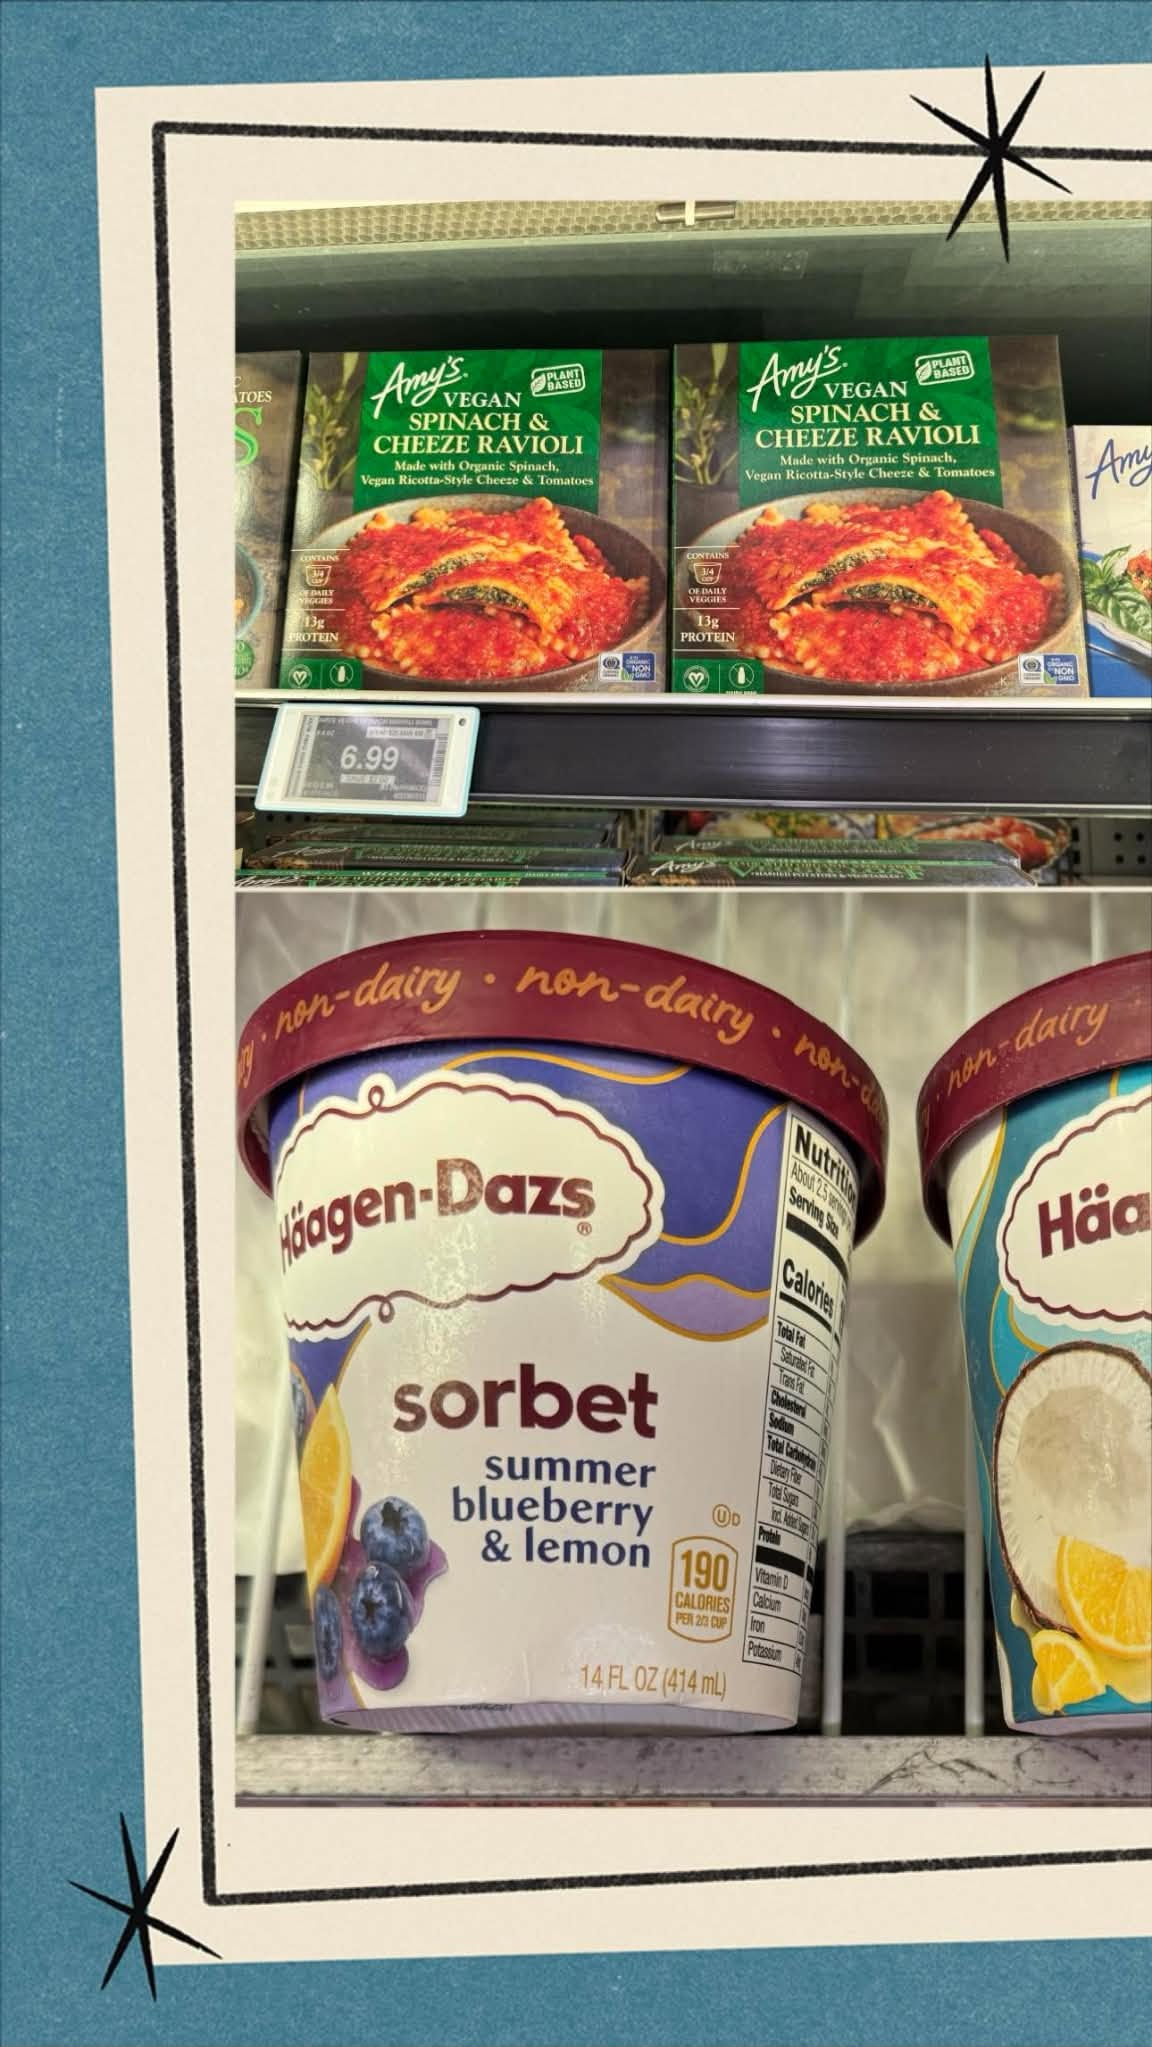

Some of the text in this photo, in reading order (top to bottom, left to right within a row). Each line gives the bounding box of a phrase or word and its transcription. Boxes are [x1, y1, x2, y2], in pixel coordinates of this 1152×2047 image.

[932, 355, 966, 369] PLANT
[547, 368, 580, 380] PLANT
[746, 344, 842, 413] Amy's
[933, 366, 970, 380] BASED
[370, 355, 464, 420] Amy's
[547, 379, 582, 391] BASED
[824, 381, 909, 399] VEGAN
[443, 392, 522, 408] VEGAN
[409, 412, 549, 431] SPINACH &
[791, 401, 942, 424] SPINACH &
[373, 435, 584, 455] CHEEZE RAVIOLI
[755, 425, 982, 449] CHEEZE RAVIOLI
[394, 460, 560, 475] Made with Organic Spinach,
[780, 452, 957, 467] Made with Organic Spinach,
[361, 474, 594, 487] Vegan Ricotta-Style Cheeze & Tomatoes
[744, 467, 995, 482] Vegan Ricotta-Style Cheeze & Tomatoes
[687, 552, 729, 560] CONTAINS
[689, 595, 727, 603] VEGGIES
[701, 587, 727, 595] DAILY
[304, 616, 325, 630] 13g
[697, 615, 719, 629] 13g
[289, 632, 339, 643] PROTEIN
[680, 632, 736, 643] PROTEIN
[340, 744, 399, 770] 6.99
[274, 961, 461, 1040] non-dairy
[515, 965, 755, 1046] non-dairy
[947, 1003, 1110, 1096] non-dairy
[791, 1160, 816, 1194] About
[279, 1157, 597, 1276] Häagen-Dazs
[788, 1185, 825, 1230] Serving
[782, 1258, 834, 1320] Calories
[777, 1320, 795, 1344] Total
[393, 1363, 659, 1439] sorbet
[767, 1434, 785, 1455] Total
[485, 1456, 656, 1488] summer
[768, 1481, 783, 1501] Total
[452, 1485, 654, 1537] blueberry
[481, 1526, 651, 1568] & lemon
[681, 1549, 729, 1592] 190
[755, 1567, 790, 1591] Vitamin D
[674, 1591, 731, 1615] CALORIES
[752, 1591, 783, 1613] Calcium
[675, 1612, 694, 1626] PER
[711, 1615, 728, 1630] CUP
[749, 1615, 766, 1633] Iron
[747, 1640, 783, 1662] Potassium
[581, 1664, 727, 1701] 14 FL OZ (414 mL)
